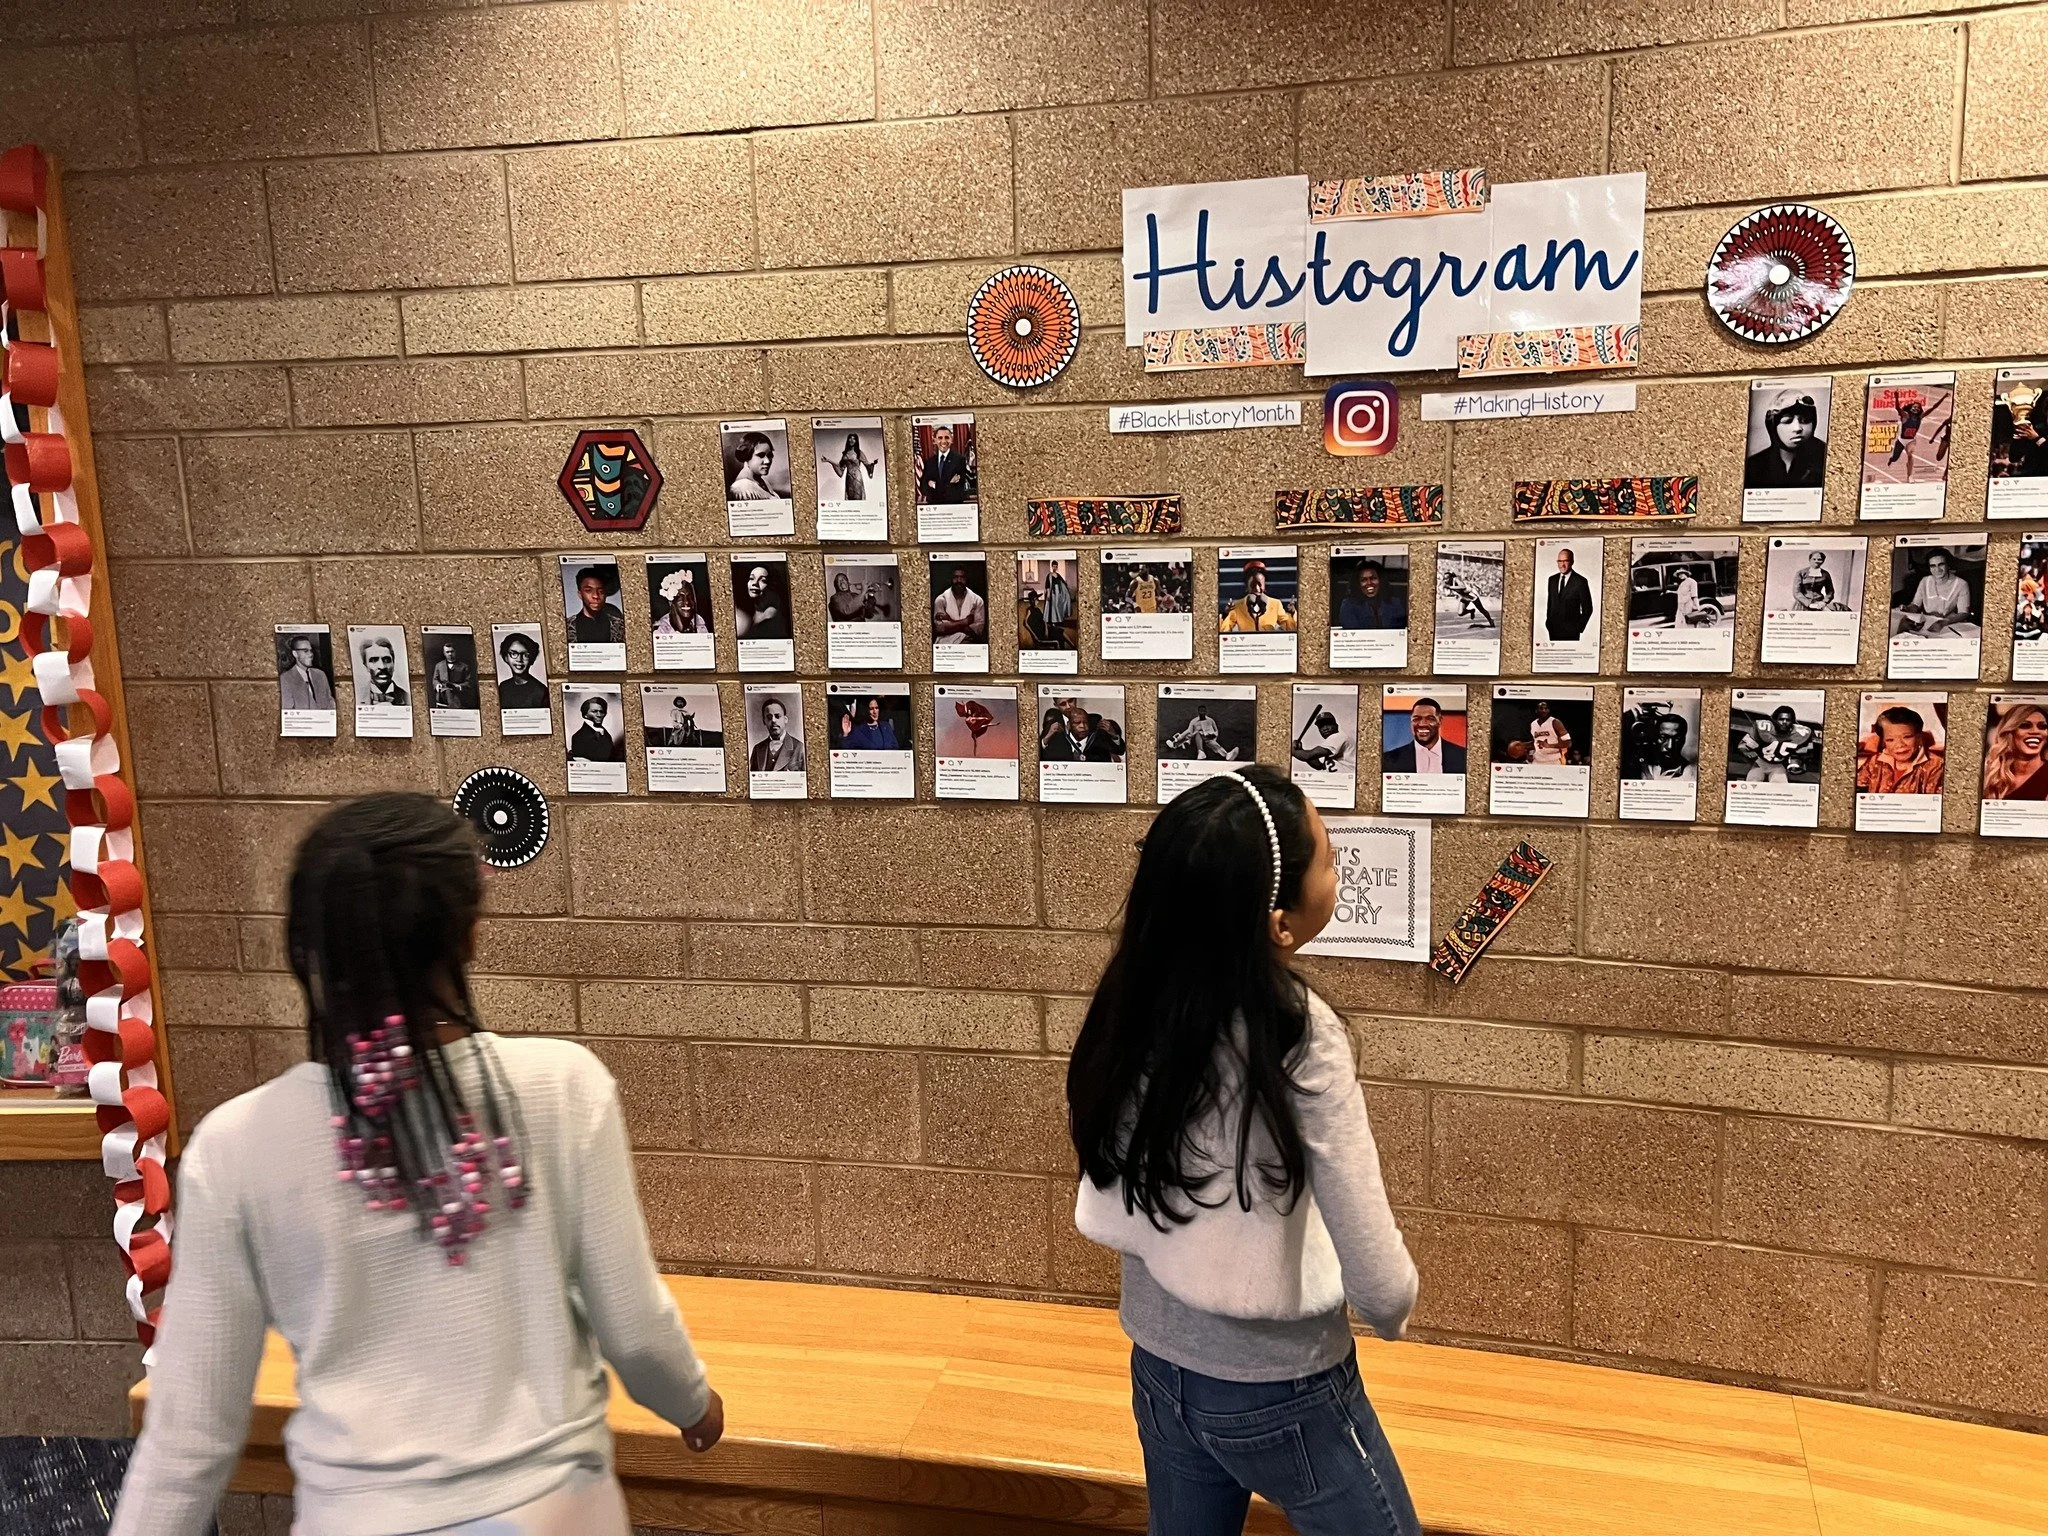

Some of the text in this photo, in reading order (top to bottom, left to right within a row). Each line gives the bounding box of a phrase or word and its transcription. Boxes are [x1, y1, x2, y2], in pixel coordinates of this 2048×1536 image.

[1132, 208, 1640, 358] Histogram
[1118, 403, 1296, 429] #BlackHistoryMonth
[1453, 391, 1604, 416] #MakingHistory
[1142, 590, 1152, 599] 23
